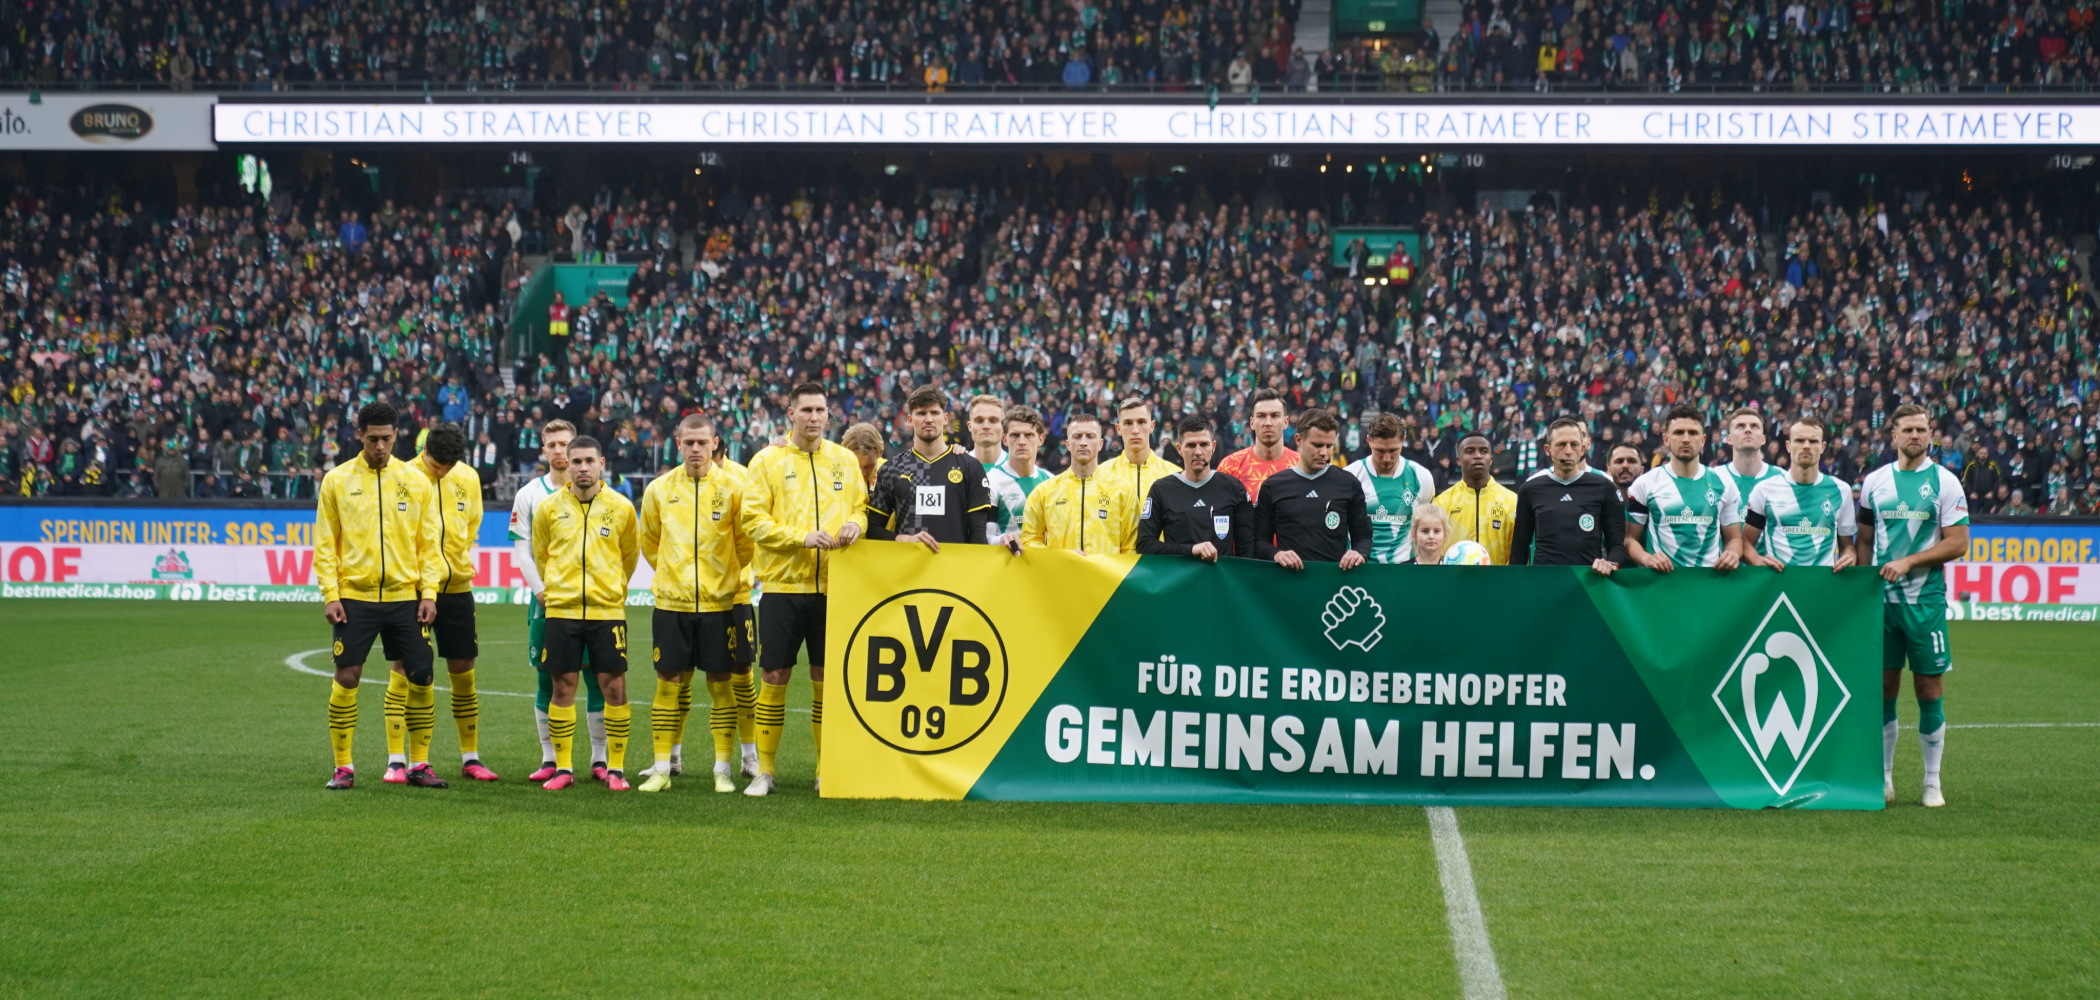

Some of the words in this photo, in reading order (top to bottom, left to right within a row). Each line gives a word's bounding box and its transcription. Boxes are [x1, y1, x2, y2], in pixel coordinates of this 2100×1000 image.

[83, 113, 139, 128] BRUNO
[243, 111, 423, 137] CHRISTIAN
[444, 111, 652, 137] STRATMEYER
[701, 111, 884, 137] CHRISTIAN
[904, 112, 1118, 137] STRATMEYER
[1168, 112, 1354, 138] CHRISTIAN
[1375, 112, 1591, 138] STRATMEYER
[1642, 112, 1832, 139] CHRISTIAN
[1853, 112, 2074, 139] STRATMEYER
[511, 152, 527, 164] 14
[700, 152, 716, 165] 12
[1273, 154, 1289, 167] 12
[1465, 154, 1482, 167] 10
[2054, 154, 2071, 168] 10
[919, 493, 942, 507] 1&1
[1664, 516, 1713, 524] GREENLEGEND
[1782, 526, 1831, 535] GREENLEGEND
[41, 520, 136, 543] SPENDEN
[144, 522, 218, 545] UNTER:
[0, 546, 82, 583] OF
[2, 582, 156, 600] bestmedical.shop
[207, 584, 257, 602] best
[259, 588, 325, 603] medica
[1953, 565, 2080, 604] HOF
[1971, 602, 2023, 620] best
[2027, 607, 2098, 622] medical
[612, 626, 626, 649] 13
[1931, 630, 1946, 654] 11
[865, 604, 992, 706] BVB
[1138, 654, 1202, 697] FÜR
[1214, 665, 1269, 699] DIE
[1281, 667, 1567, 707] ERDBEBENOPFER
[901, 704, 946, 740] 09
[1044, 704, 1400, 776] GEMEINSAM
[1420, 721, 1656, 781] HELFEN.
